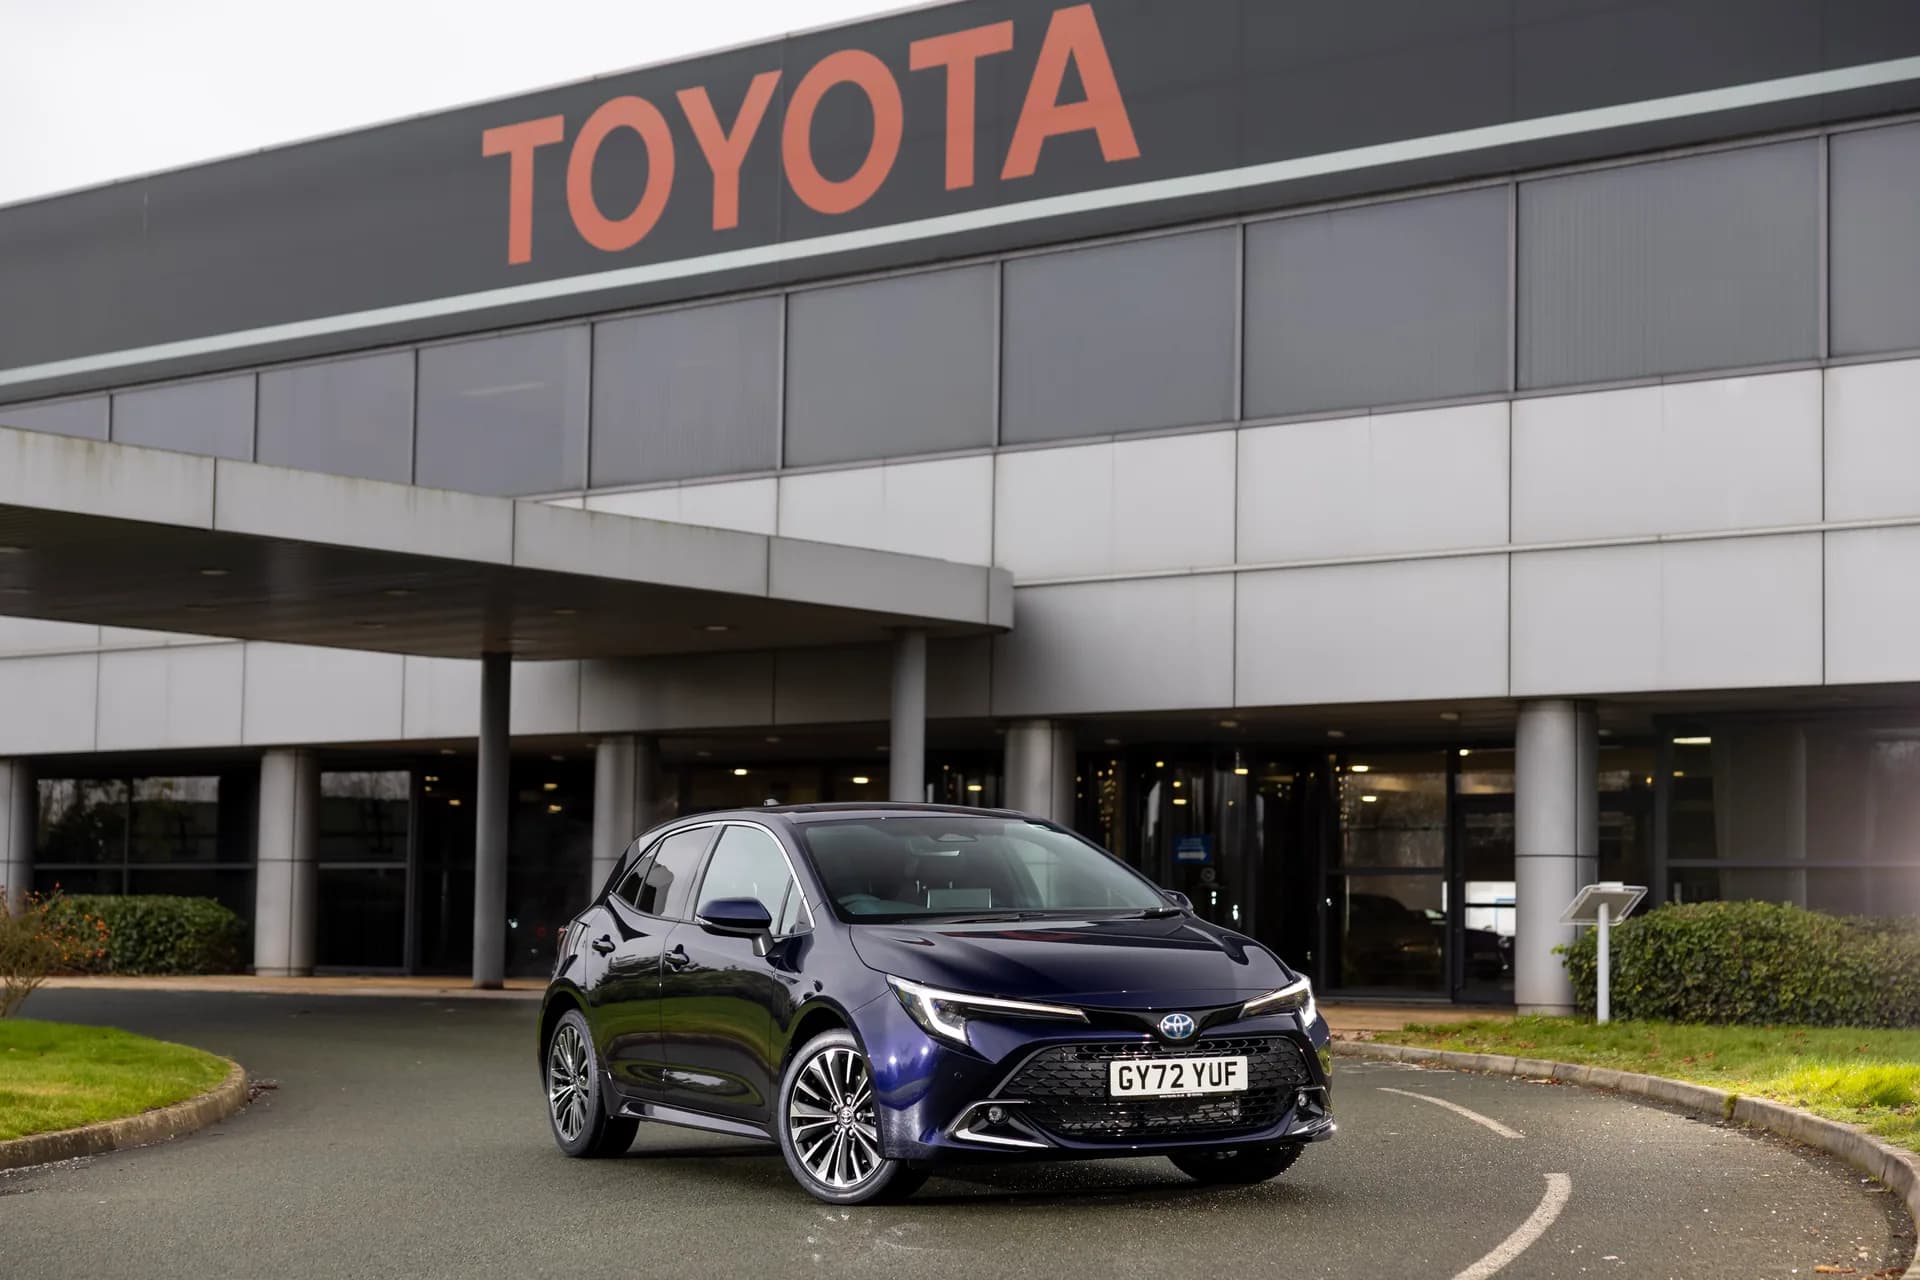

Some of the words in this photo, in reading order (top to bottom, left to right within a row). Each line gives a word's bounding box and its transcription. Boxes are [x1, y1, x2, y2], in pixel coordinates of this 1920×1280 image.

[482, 4, 1140, 265] TOYOTA
[1118, 1064, 1184, 1090] GY72
[1192, 1061, 1238, 1087] YUF
